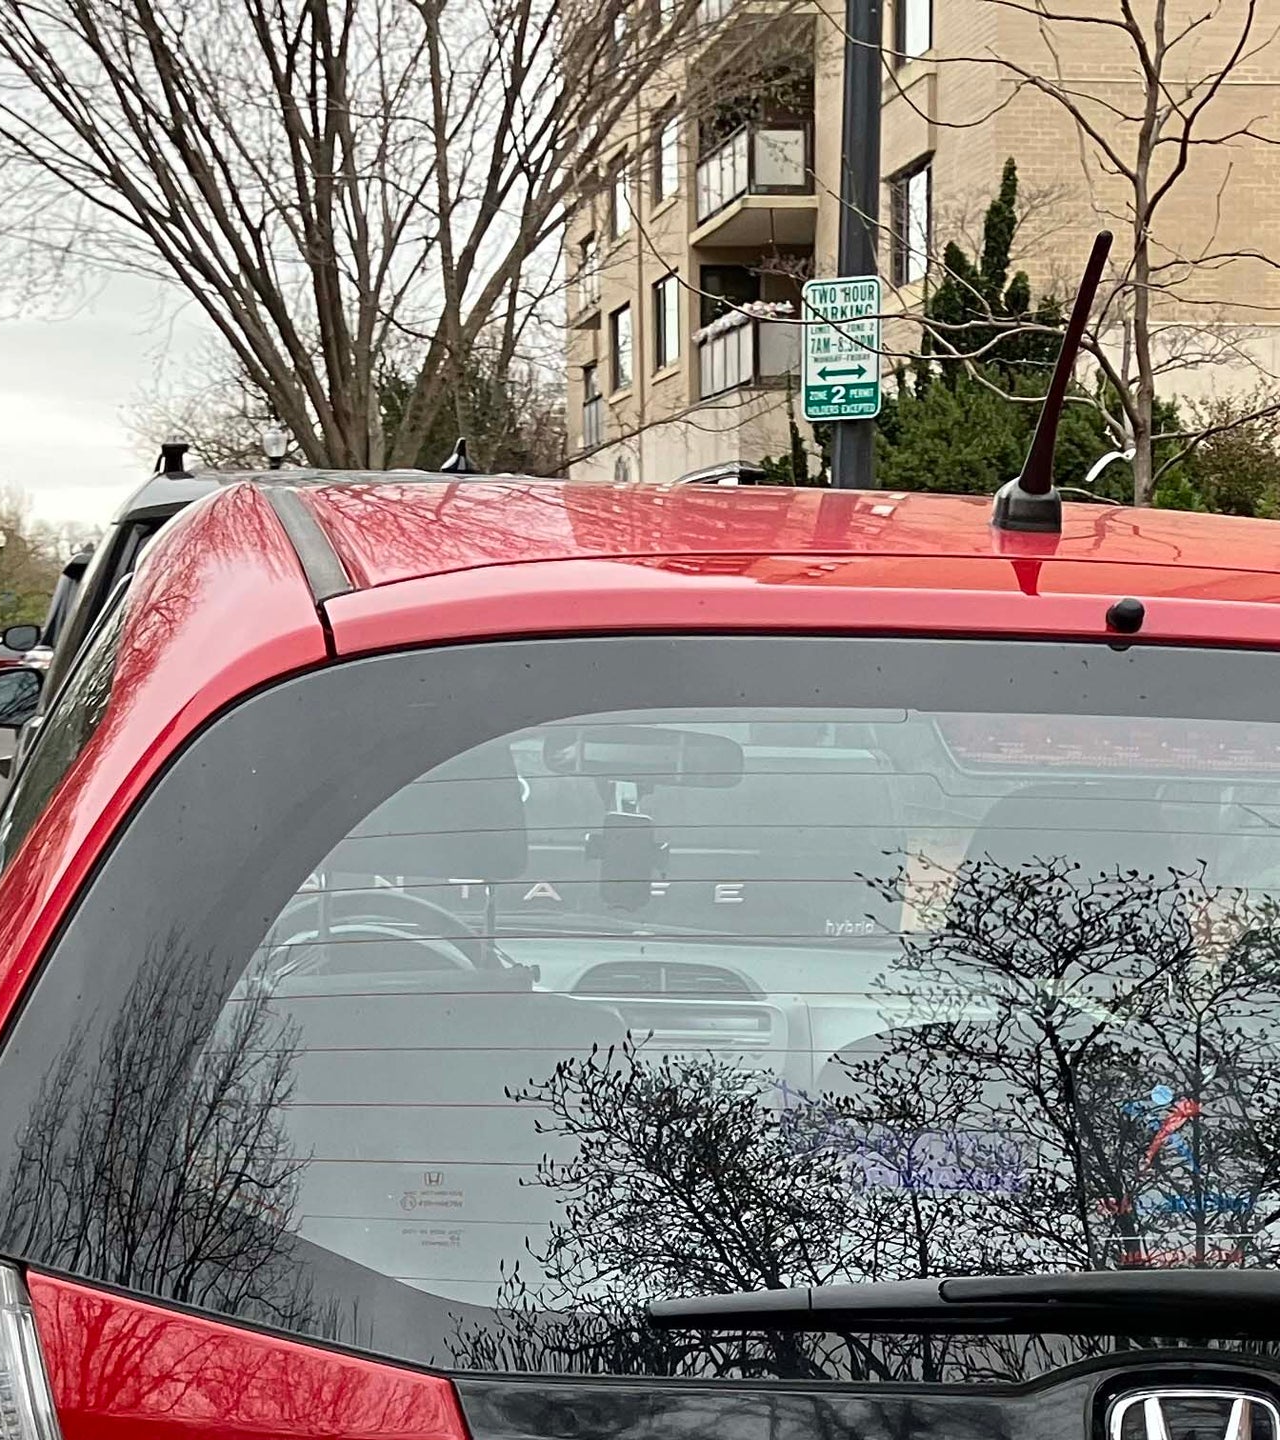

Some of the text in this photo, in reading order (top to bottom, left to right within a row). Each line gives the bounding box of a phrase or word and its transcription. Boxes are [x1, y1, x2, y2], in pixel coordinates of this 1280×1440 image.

[811, 285, 874, 305] TWO HOUR
[813, 304, 873, 320] PARKING
[831, 386, 846, 403] 2
[849, 388, 874, 399] PERMIT
[296, 872, 562, 901] ANTA
[825, 919, 874, 935] hybrid
